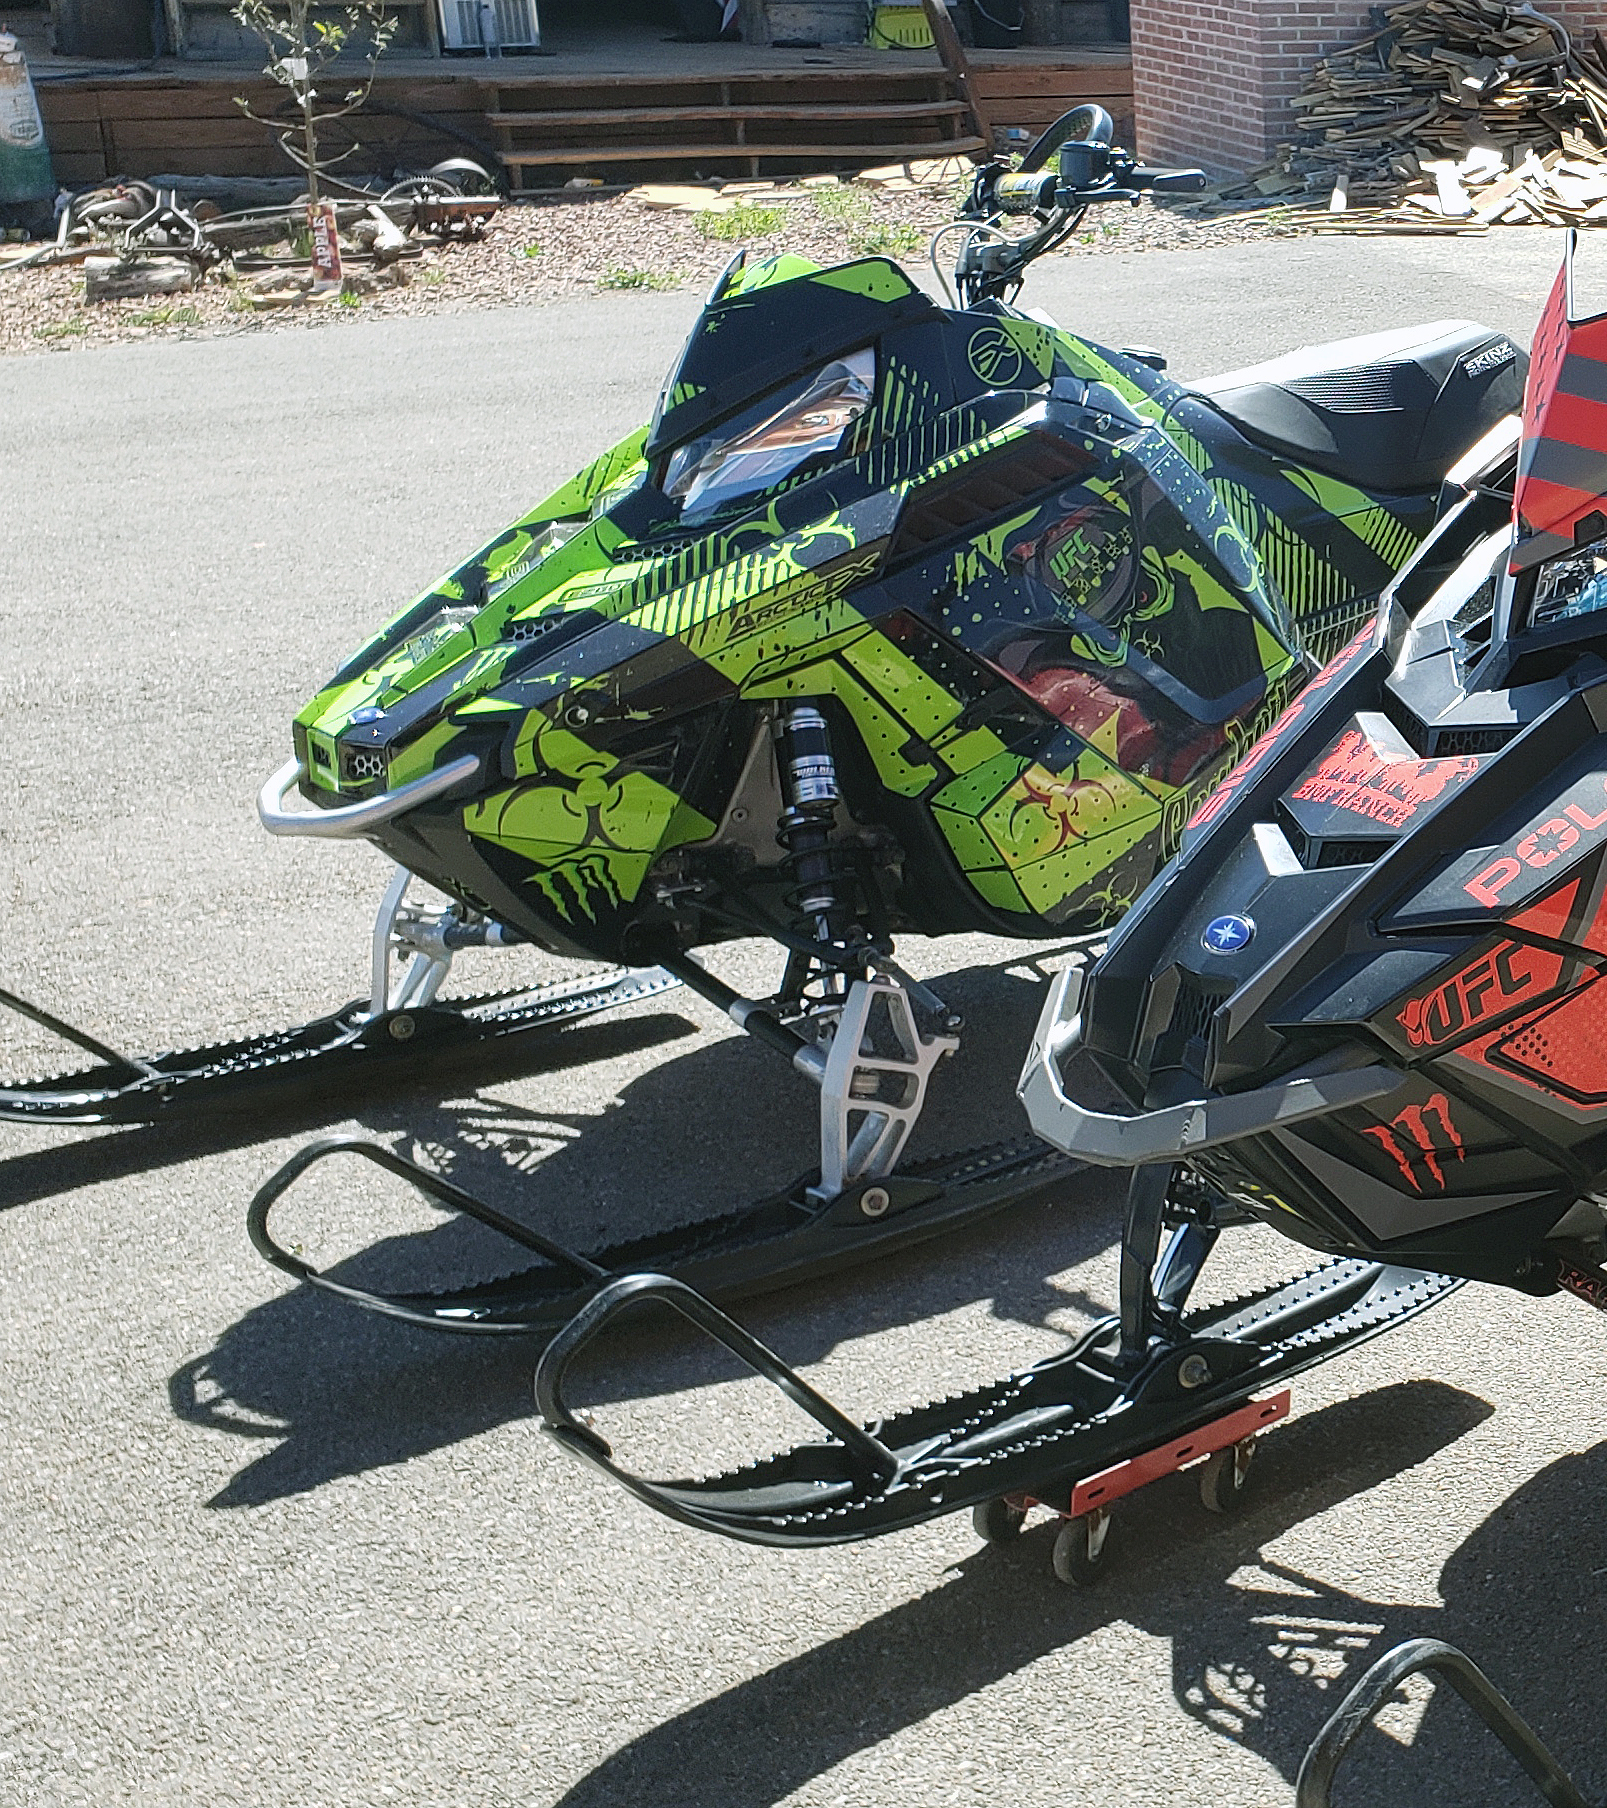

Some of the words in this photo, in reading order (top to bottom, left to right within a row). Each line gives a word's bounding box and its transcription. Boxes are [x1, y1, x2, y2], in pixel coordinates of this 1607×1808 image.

[313, 216, 332, 268] APPLE
[1463, 342, 1514, 373] SKINZ
[1049, 526, 1092, 581] UFC
[1428, 942, 1532, 1042] UFC
